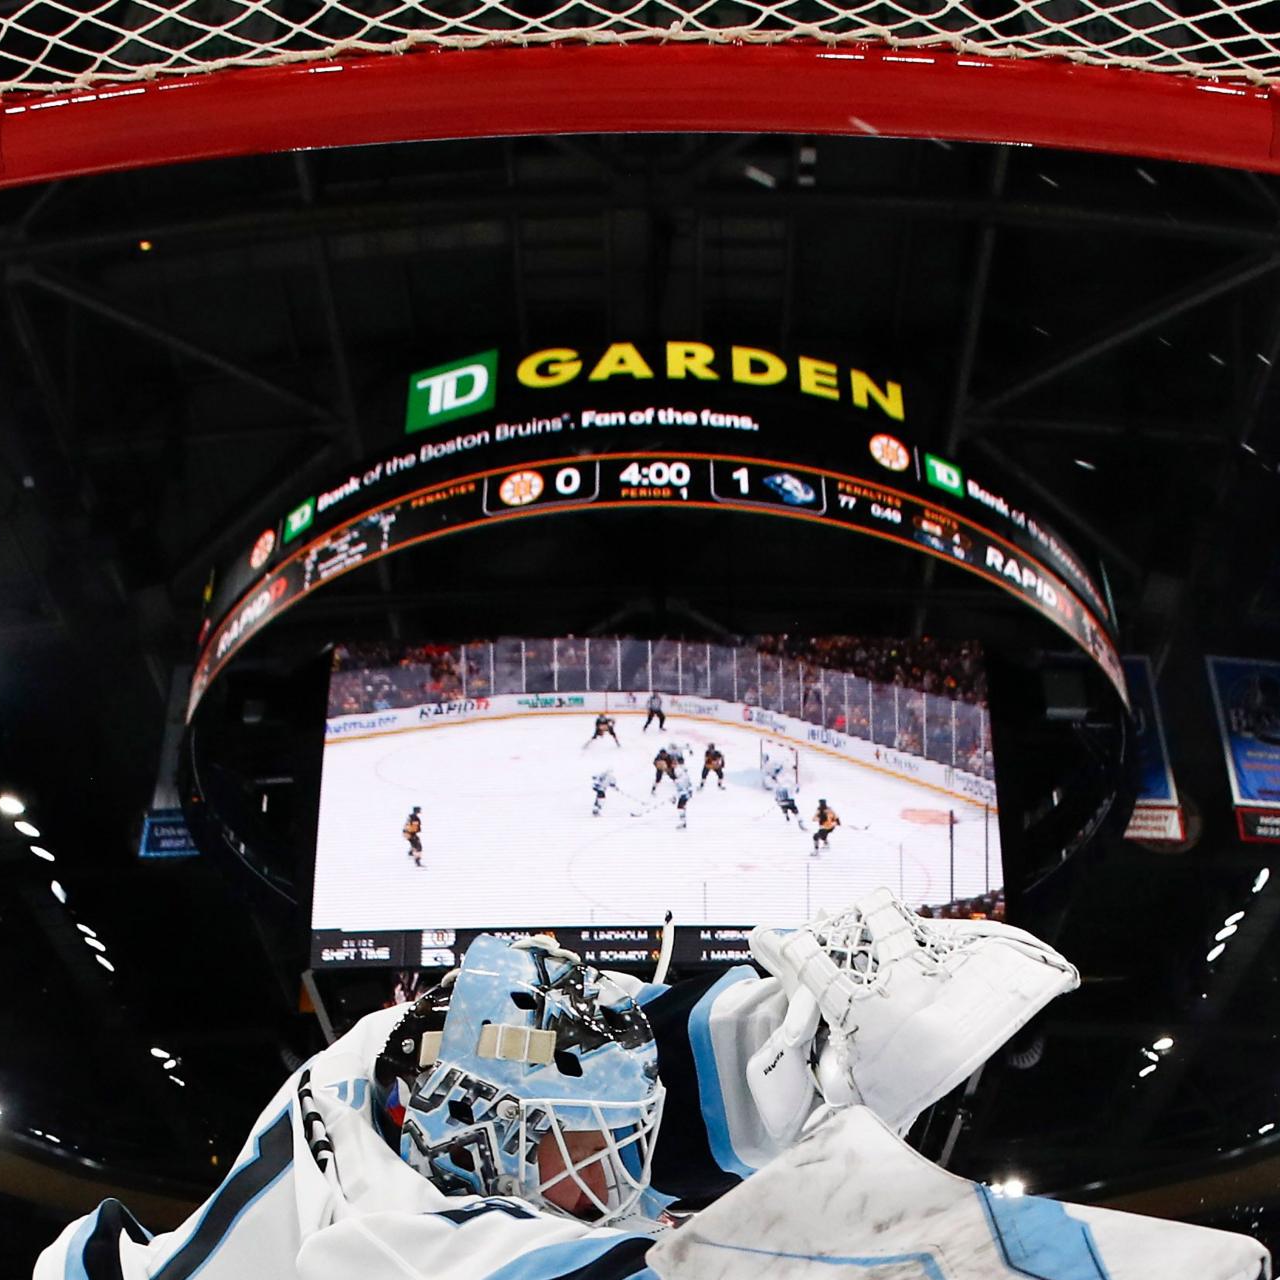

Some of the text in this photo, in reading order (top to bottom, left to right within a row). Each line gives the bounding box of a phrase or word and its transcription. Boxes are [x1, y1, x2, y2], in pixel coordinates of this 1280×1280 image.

[517, 341, 906, 421] GARDEN
[317, 477, 362, 512] Bank
[363, 462, 384, 486] of
[385, 452, 417, 473] the
[420, 429, 491, 463] Boston
[581, 409, 627, 429] Fan
[628, 406, 656, 426] of
[657, 406, 698, 426] the
[700, 408, 760, 431] fans.
[555, 467, 582, 495] 0
[620, 461, 691, 487] 4:00
[732, 467, 750, 495] 1
[621, 487, 689, 500] PERIOD 1
[837, 493, 857, 510] 77
[967, 478, 1010, 518] Bank
